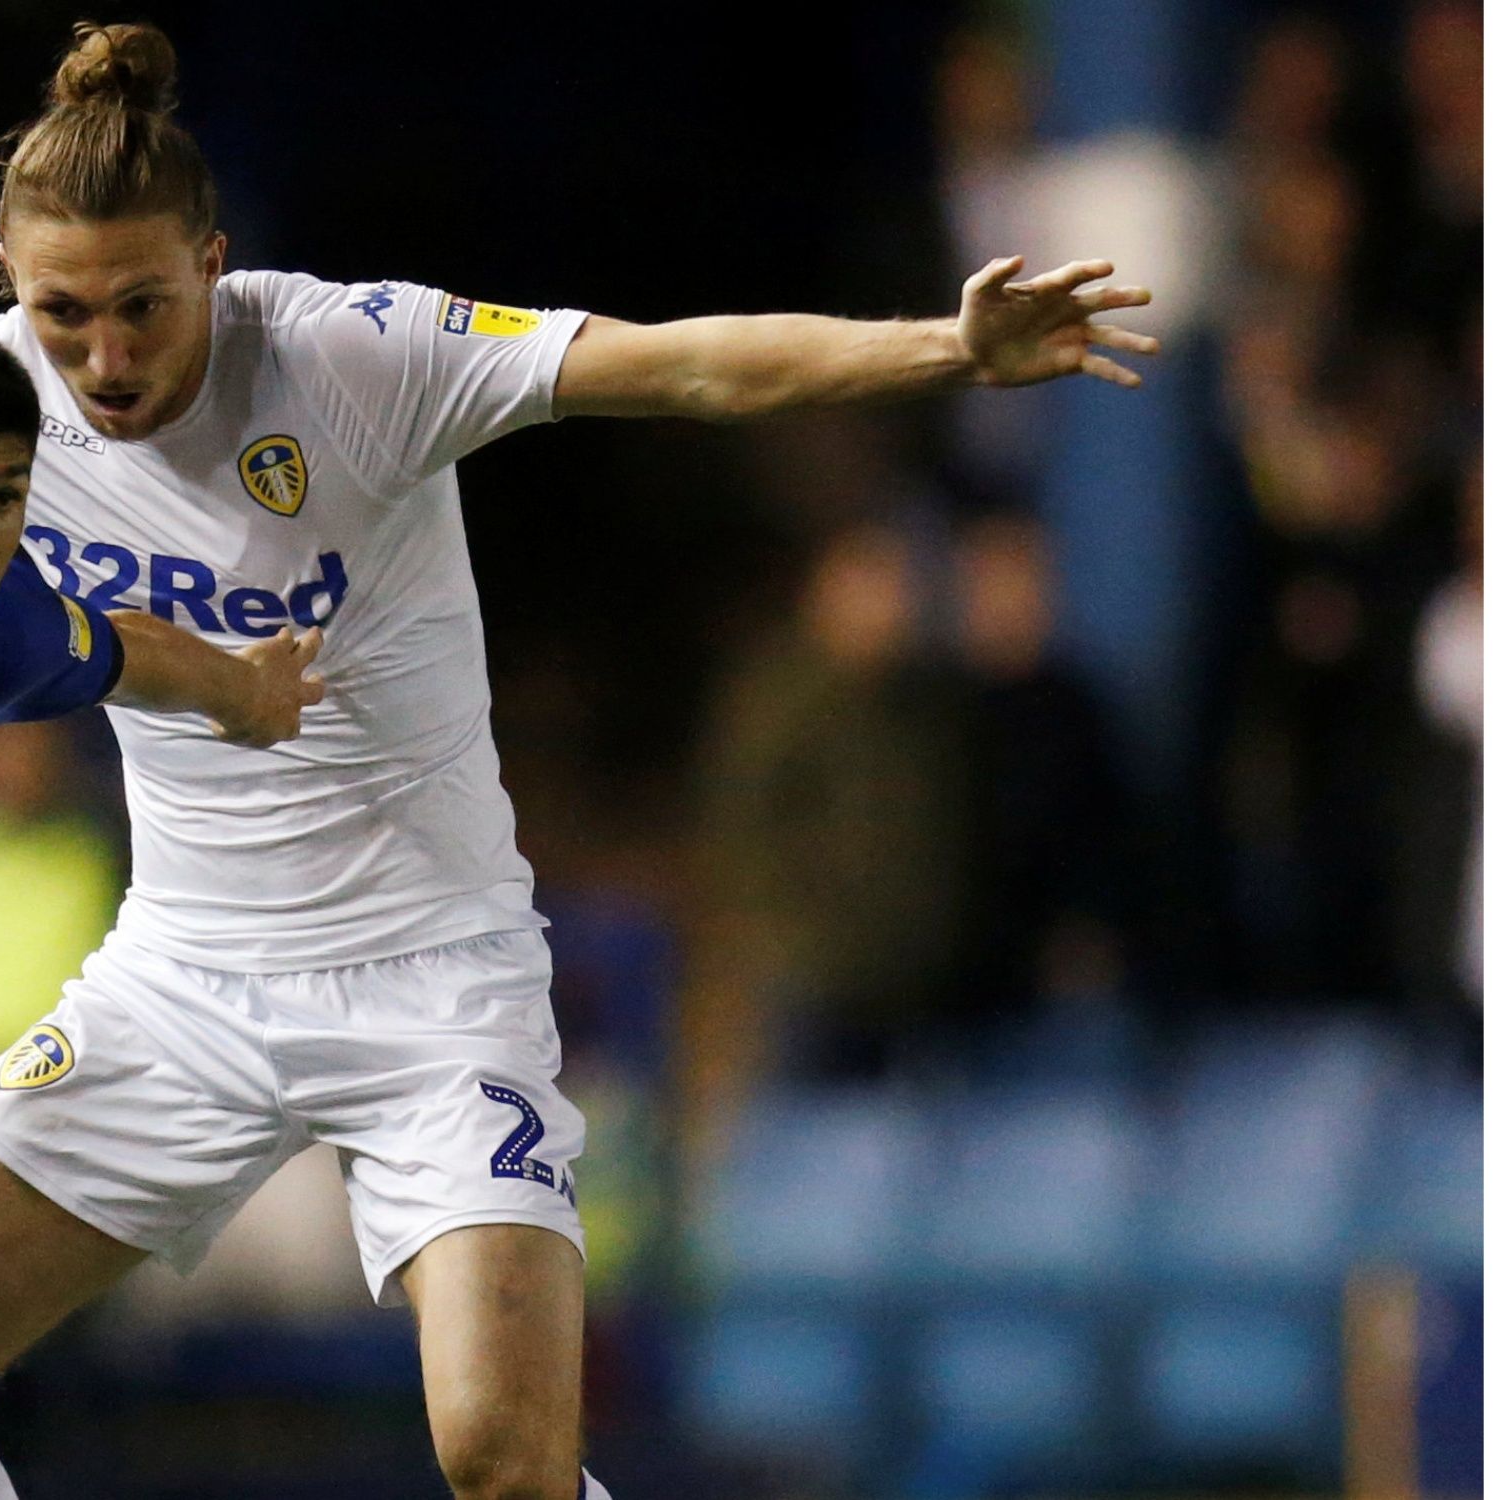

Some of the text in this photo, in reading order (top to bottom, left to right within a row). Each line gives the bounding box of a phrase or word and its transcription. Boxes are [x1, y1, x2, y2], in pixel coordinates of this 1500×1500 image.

[448, 306, 471, 331] sky
[41, 412, 106, 455] ppa
[24, 525, 349, 638] 32Red
[479, 1081, 555, 1189] 2
